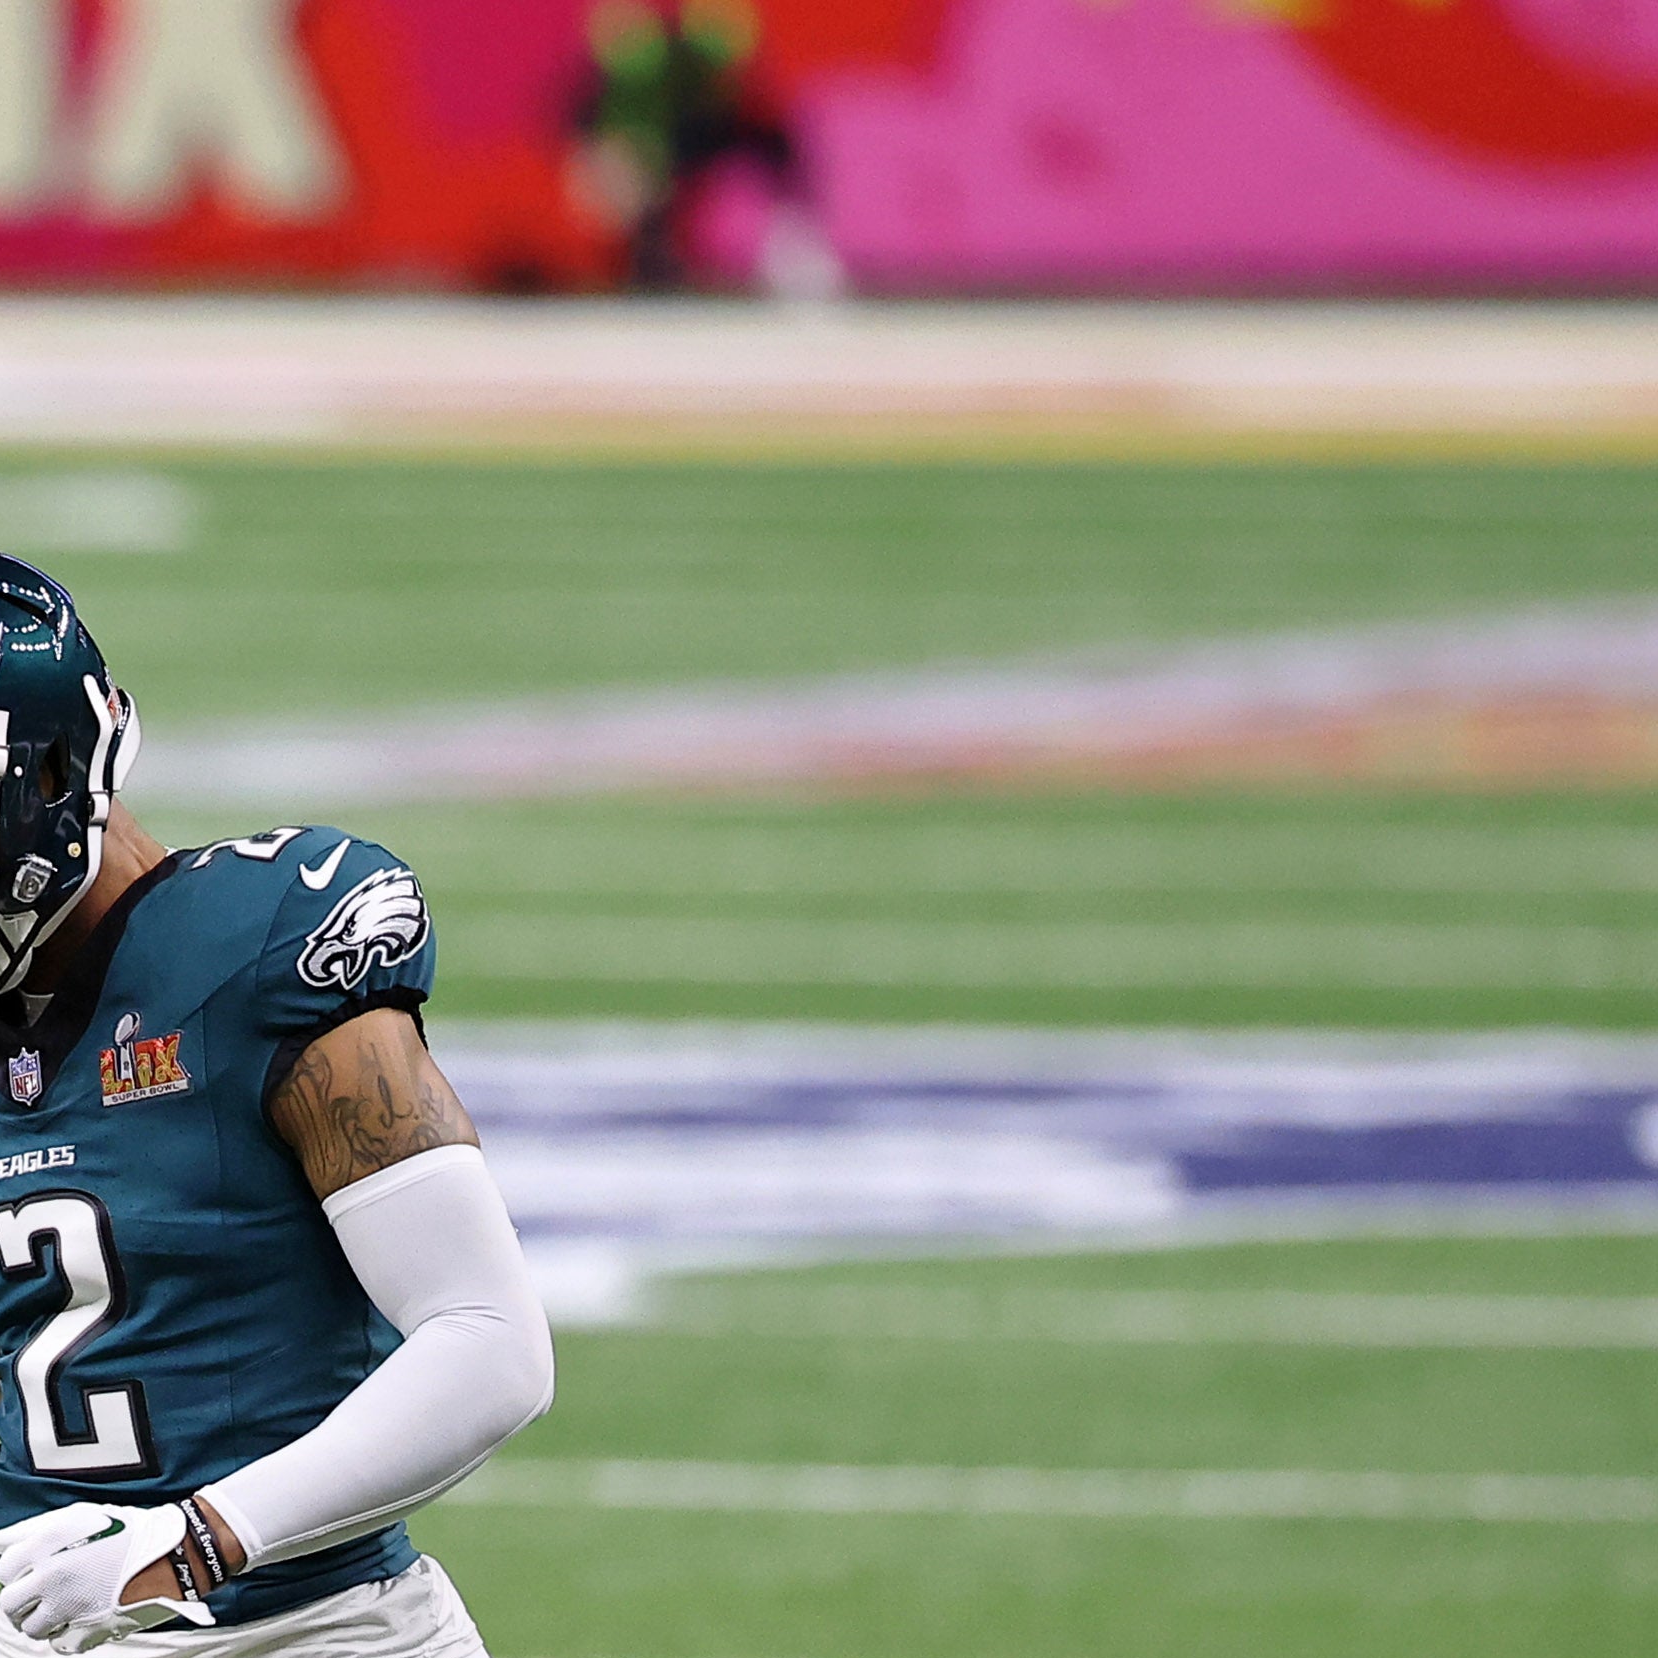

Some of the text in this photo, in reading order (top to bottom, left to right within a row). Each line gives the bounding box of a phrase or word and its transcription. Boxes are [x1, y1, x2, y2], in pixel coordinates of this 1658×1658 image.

[13, 1071, 38, 1097] NFL
[111, 1082, 181, 1104] SUPER BOWL
[179, 1498, 207, 1535] Outwork
[199, 1532, 224, 1583] Everyone
